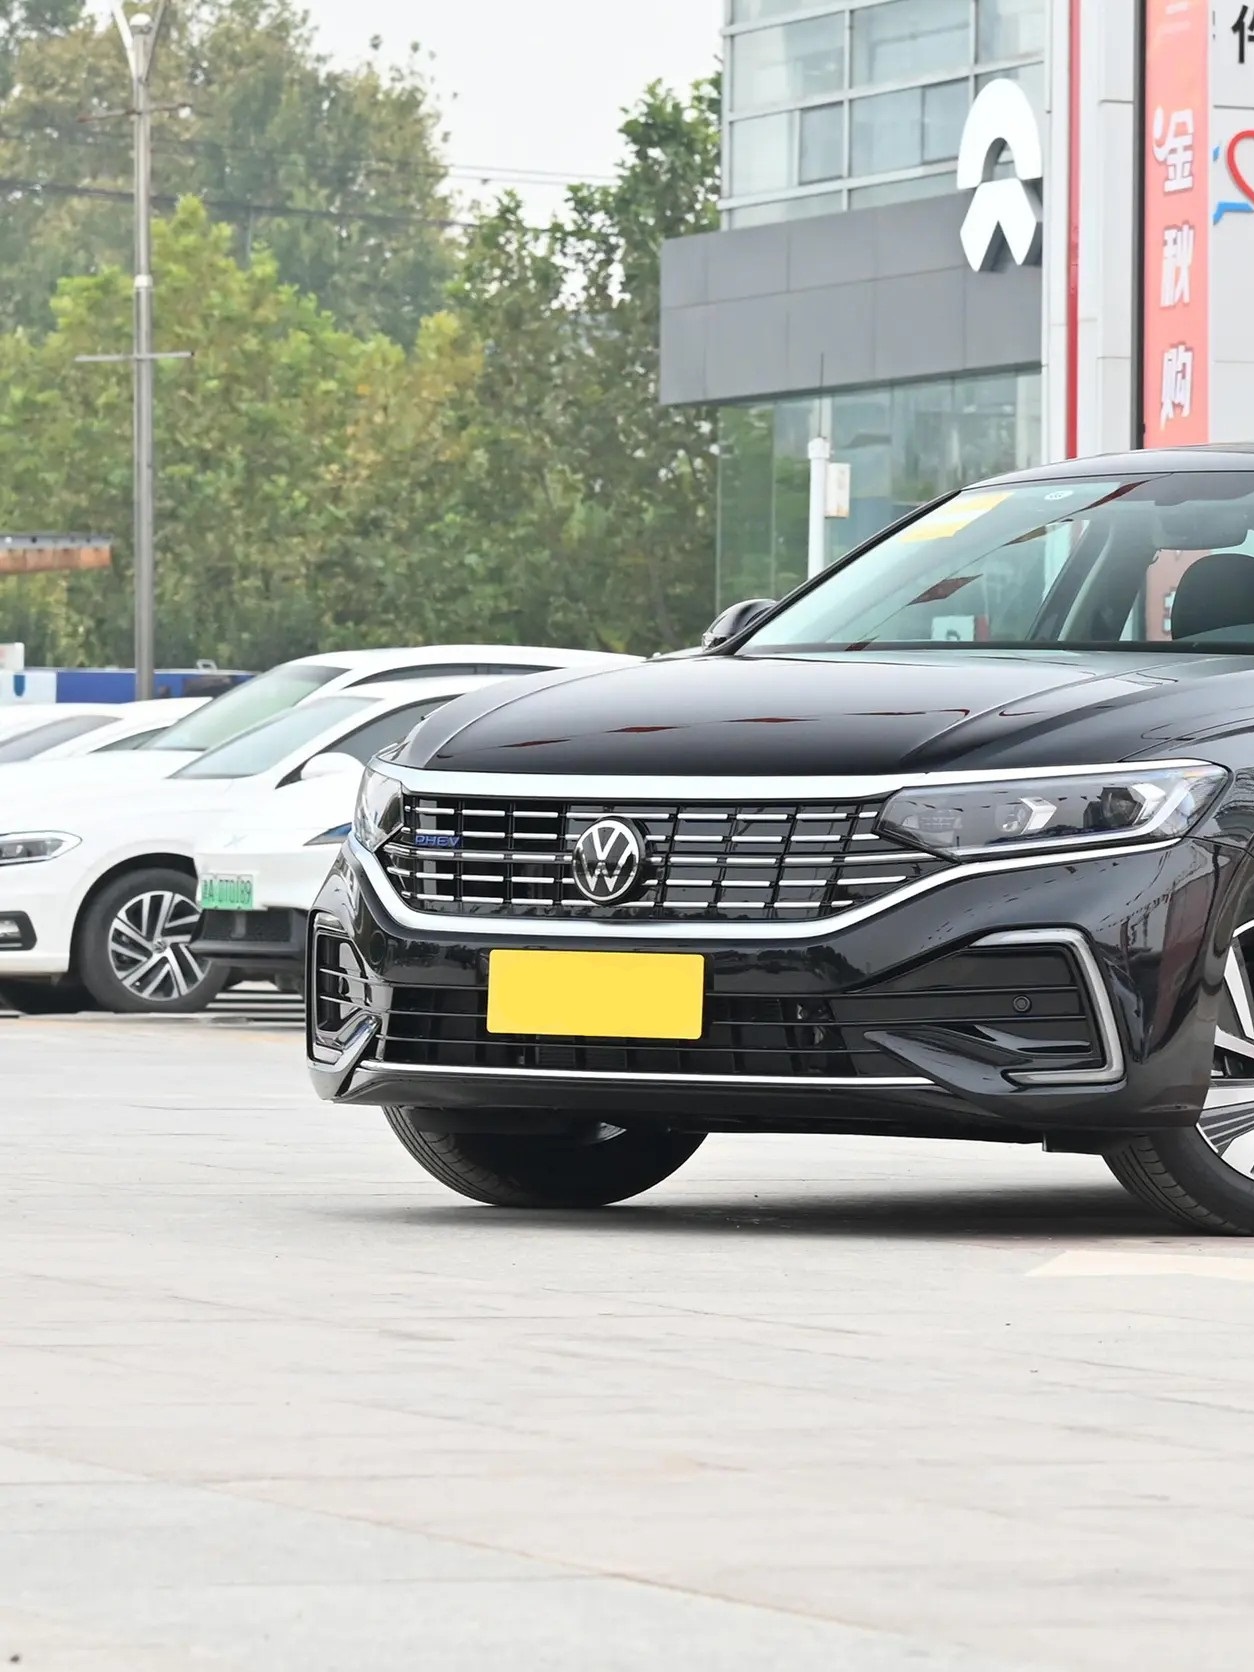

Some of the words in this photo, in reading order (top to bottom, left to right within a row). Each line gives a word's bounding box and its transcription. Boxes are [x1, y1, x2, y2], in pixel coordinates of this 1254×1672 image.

[1152, 106, 1195, 431] 金秋购
[415, 835, 460, 848] PHEV
